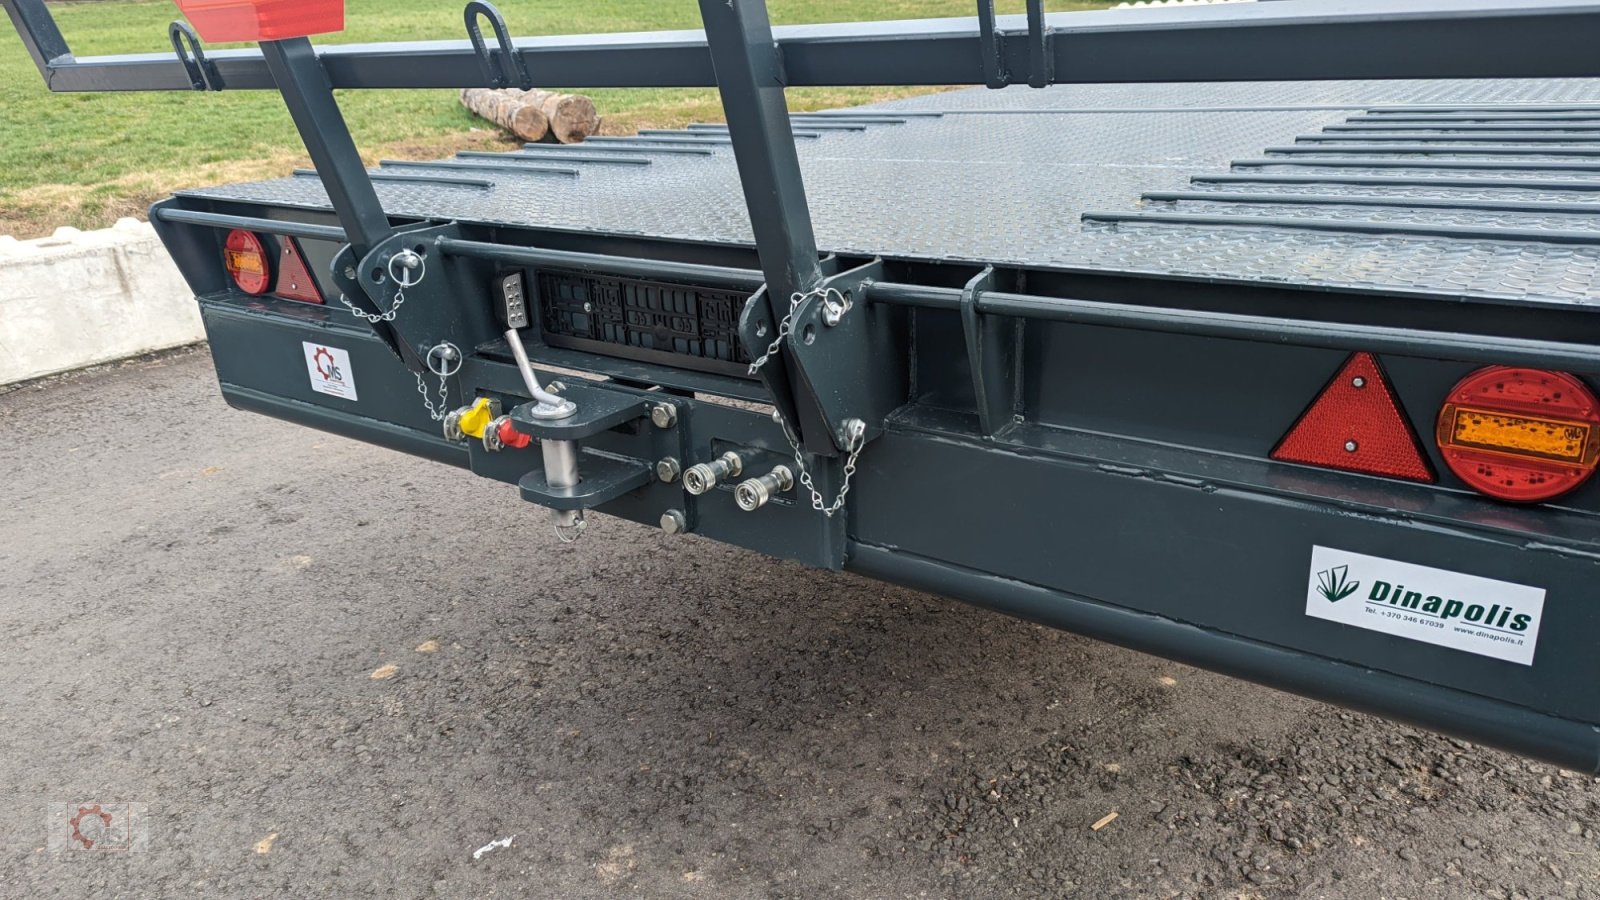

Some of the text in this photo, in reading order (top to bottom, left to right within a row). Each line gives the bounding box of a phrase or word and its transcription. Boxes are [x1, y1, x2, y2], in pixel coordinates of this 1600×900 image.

[1365, 606, 1524, 645] Tel. +370 346 67039 www.dinapolis.lt
[1368, 580, 1532, 631] Dinapolis
